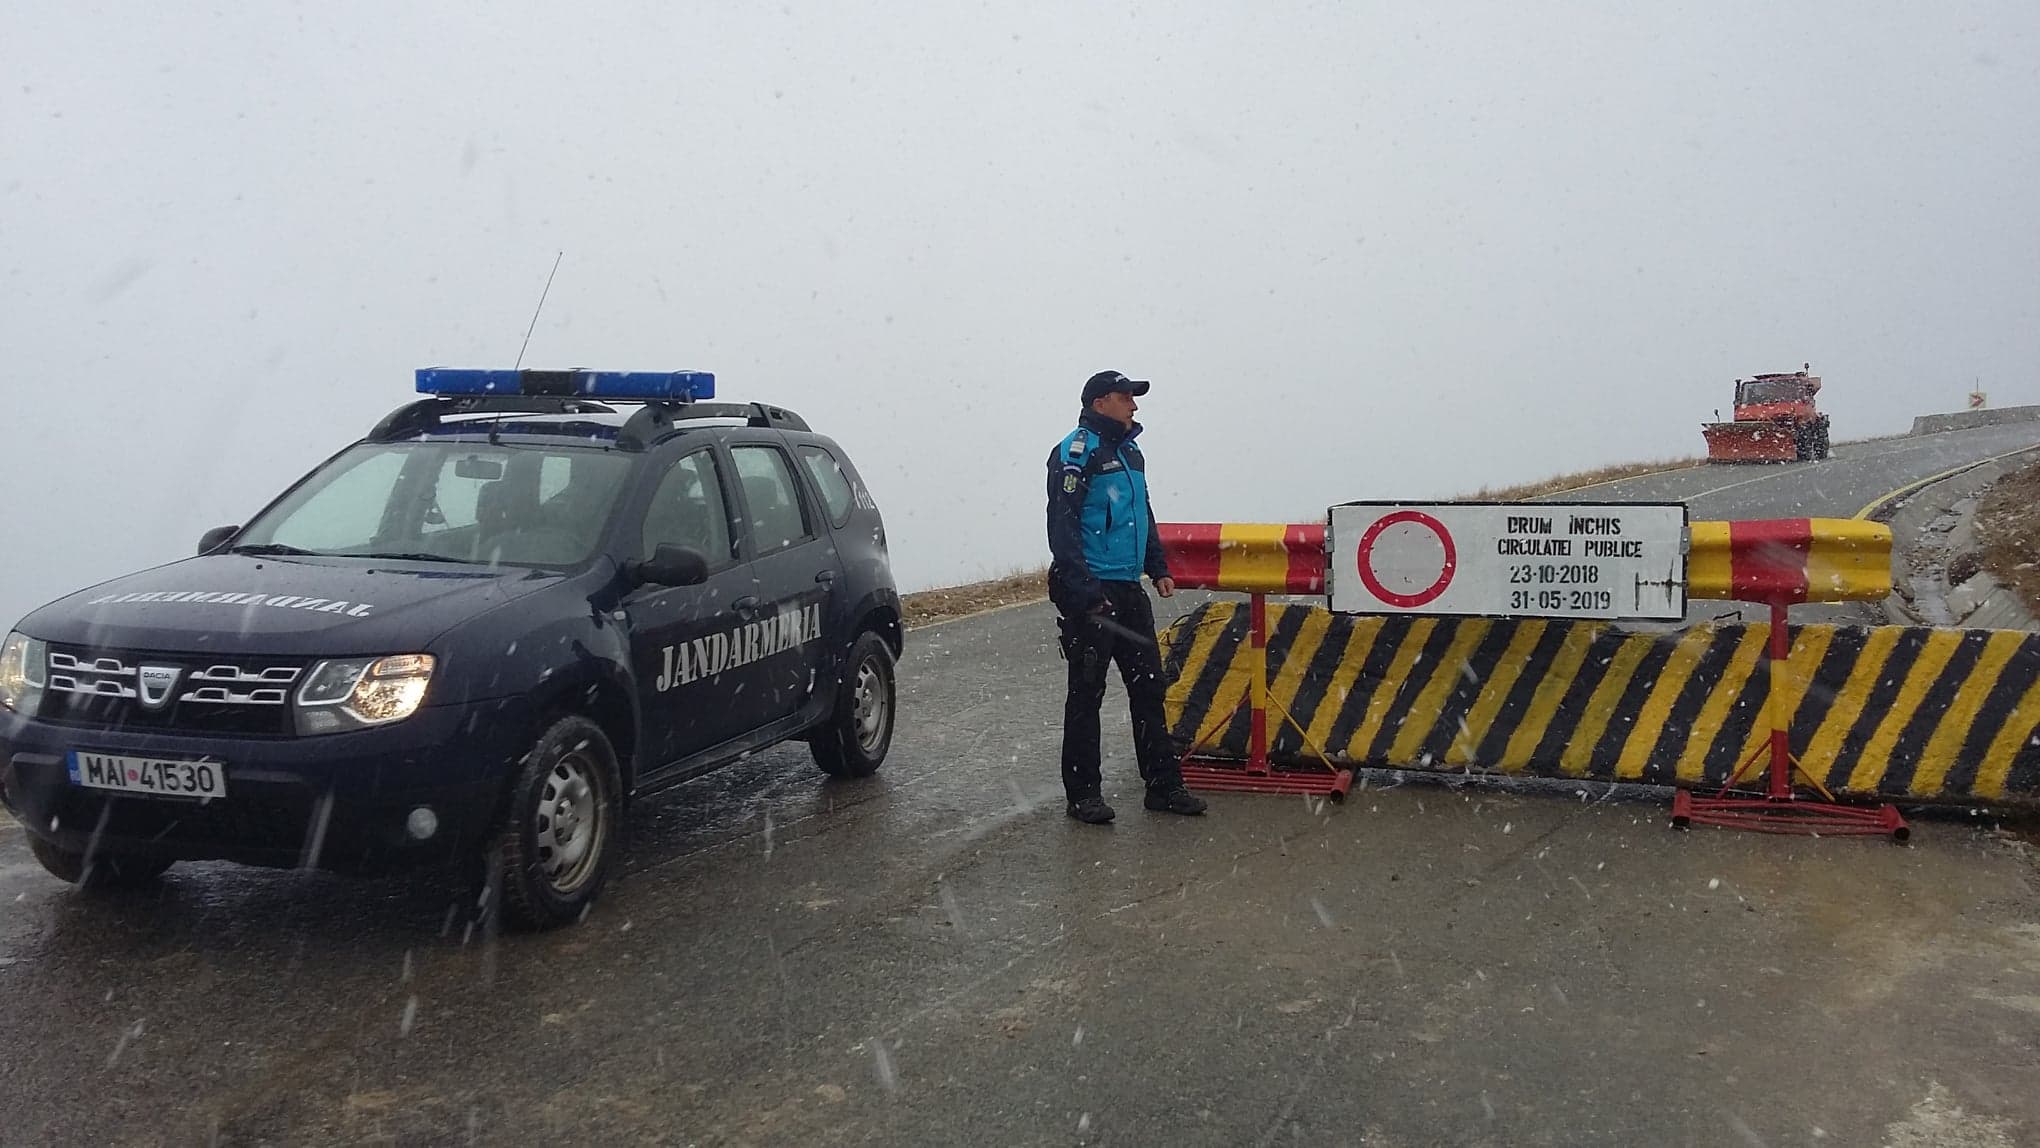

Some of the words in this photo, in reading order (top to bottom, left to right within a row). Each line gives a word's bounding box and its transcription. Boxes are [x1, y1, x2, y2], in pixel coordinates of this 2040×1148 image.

[1507, 516, 1552, 534] DRUM
[1585, 540, 1643, 558] PUBLICE
[656, 602, 822, 692] JANDARMERIA
[143, 671, 171, 680] DACIA
[86, 756, 127, 786] MAI
[140, 761, 215, 793] 41530
